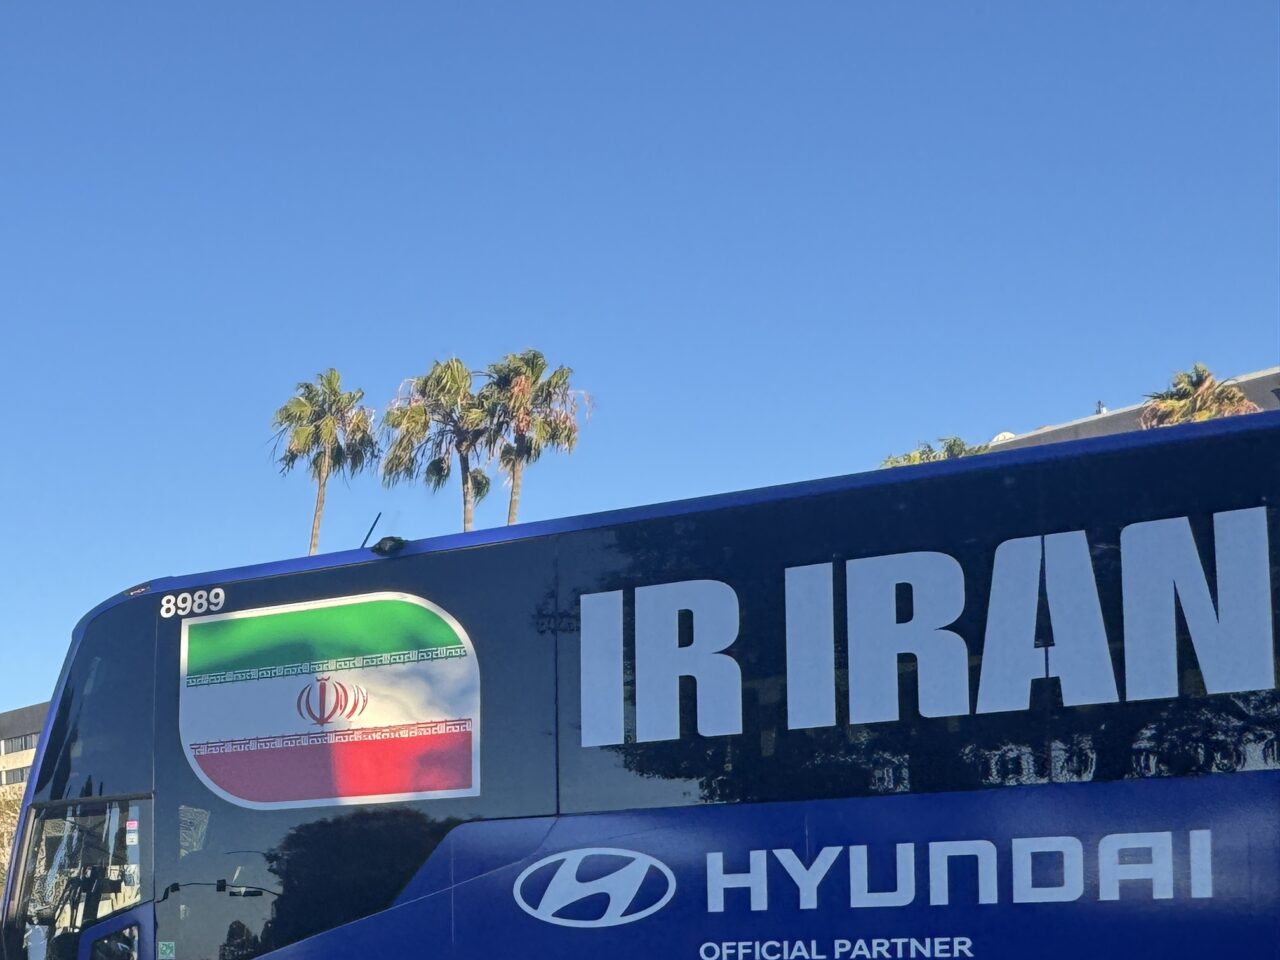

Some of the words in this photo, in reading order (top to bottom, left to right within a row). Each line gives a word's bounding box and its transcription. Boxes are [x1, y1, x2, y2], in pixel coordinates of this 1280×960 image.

[160, 587, 225, 618] 8989
[580, 579, 744, 748] IR
[785, 506, 1276, 731] IRAN
[706, 829, 1213, 913] HYUNDAI
[834, 936, 974, 960] PARTNER
